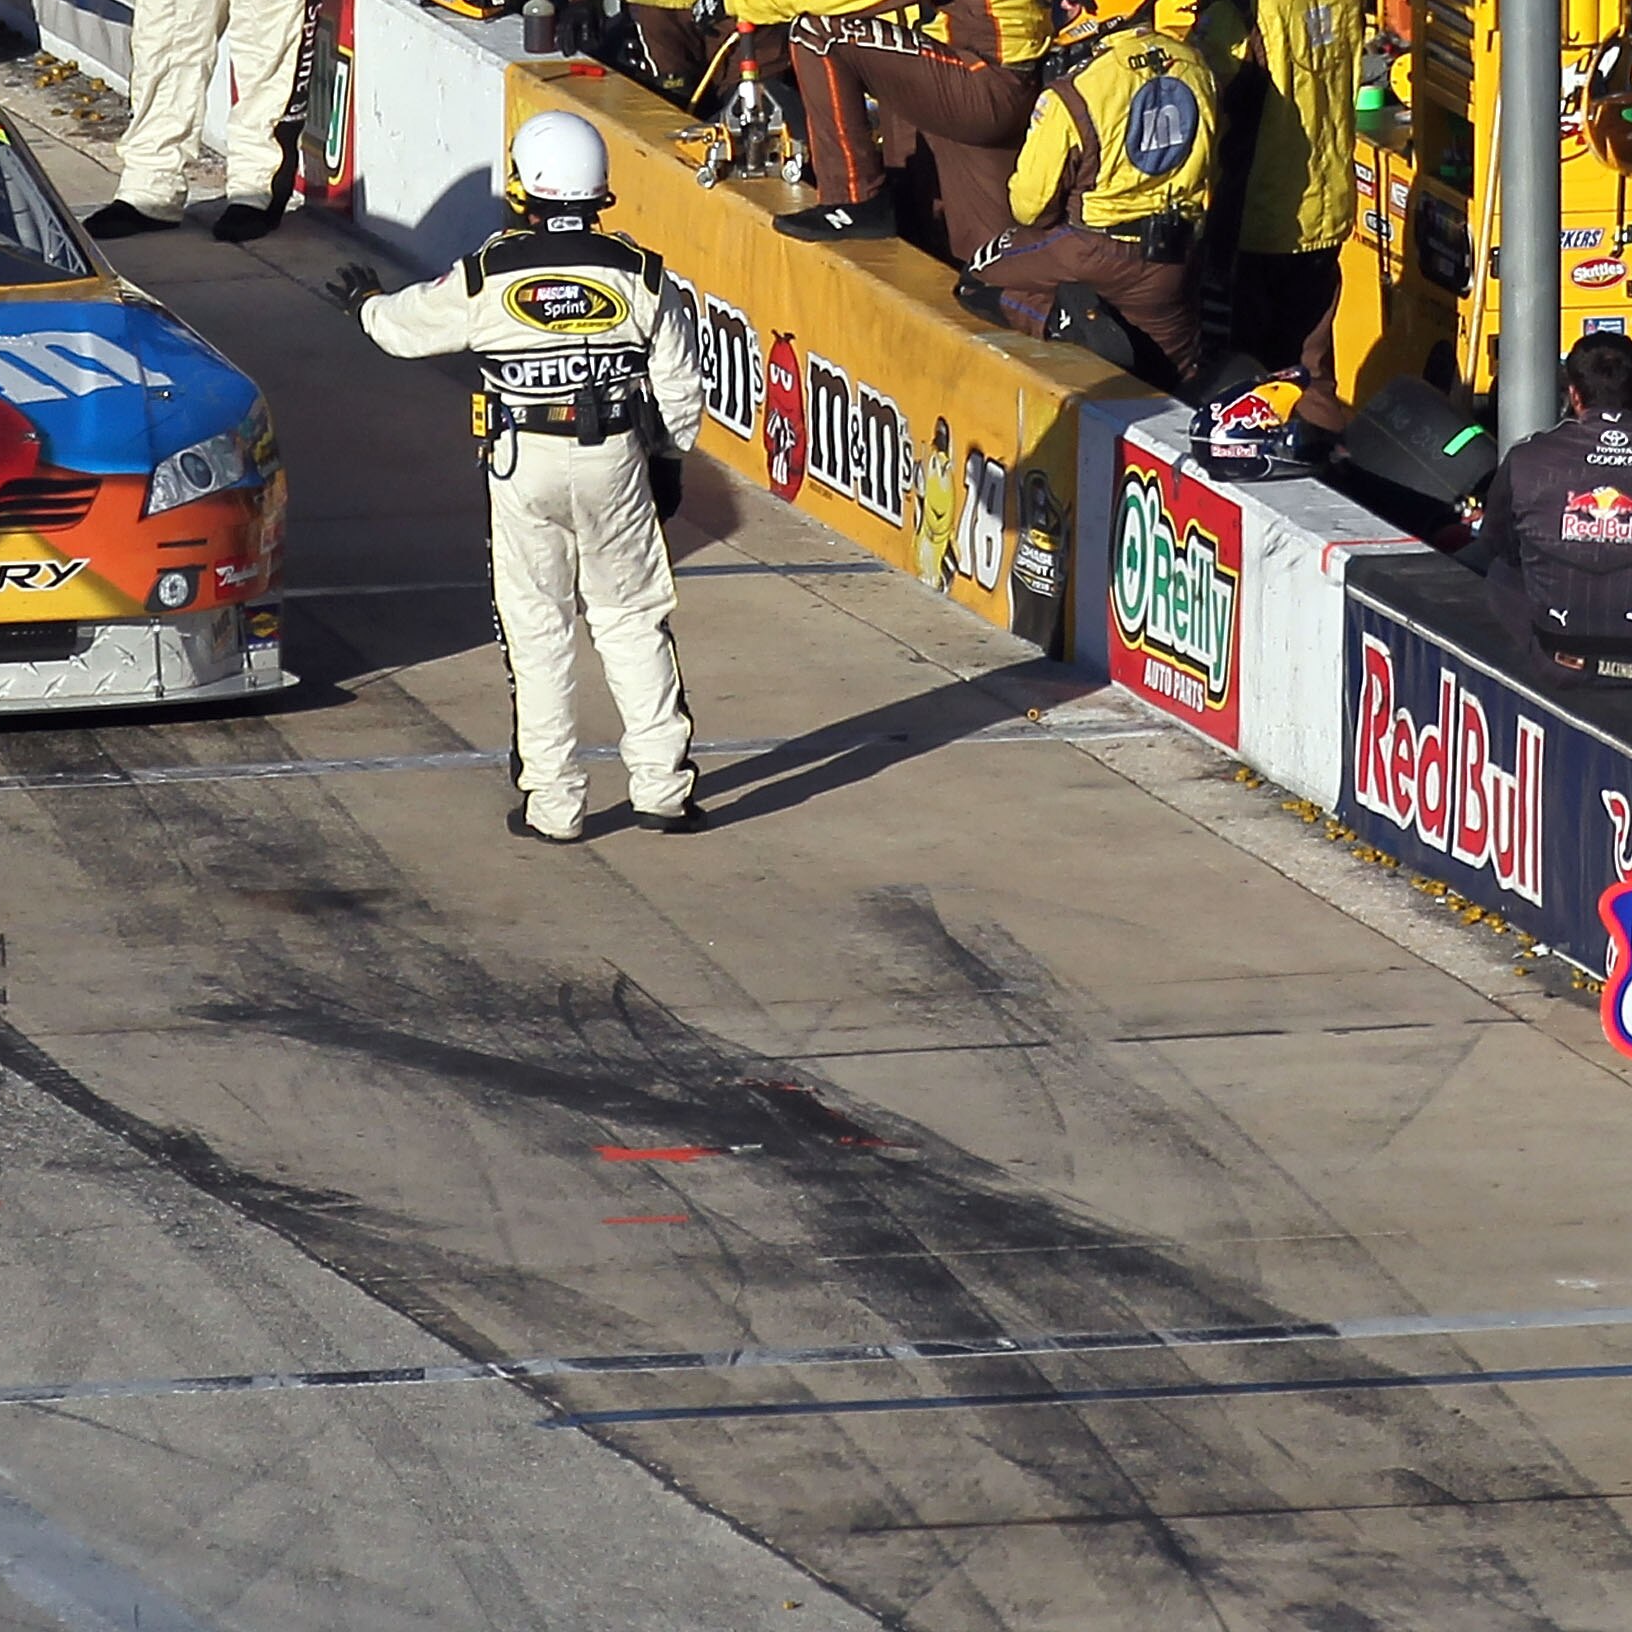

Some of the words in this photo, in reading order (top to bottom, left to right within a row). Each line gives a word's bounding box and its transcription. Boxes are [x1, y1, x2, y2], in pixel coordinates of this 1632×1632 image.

[1560, 229, 1603, 249] KERS
[1572, 262, 1625, 283] Skittles
[536, 286, 580, 300] NASCAR
[542, 299, 587, 317] Sprint
[806, 350, 915, 529] m&m's
[954, 441, 1009, 592] 18
[1563, 514, 1602, 538] Red
[1112, 466, 1235, 704] O'Reilly
[1143, 659, 1173, 700] AUTO
[1172, 673, 1205, 713] PARTS
[1356, 631, 1456, 847] Red
[1451, 685, 1543, 907] Bull
